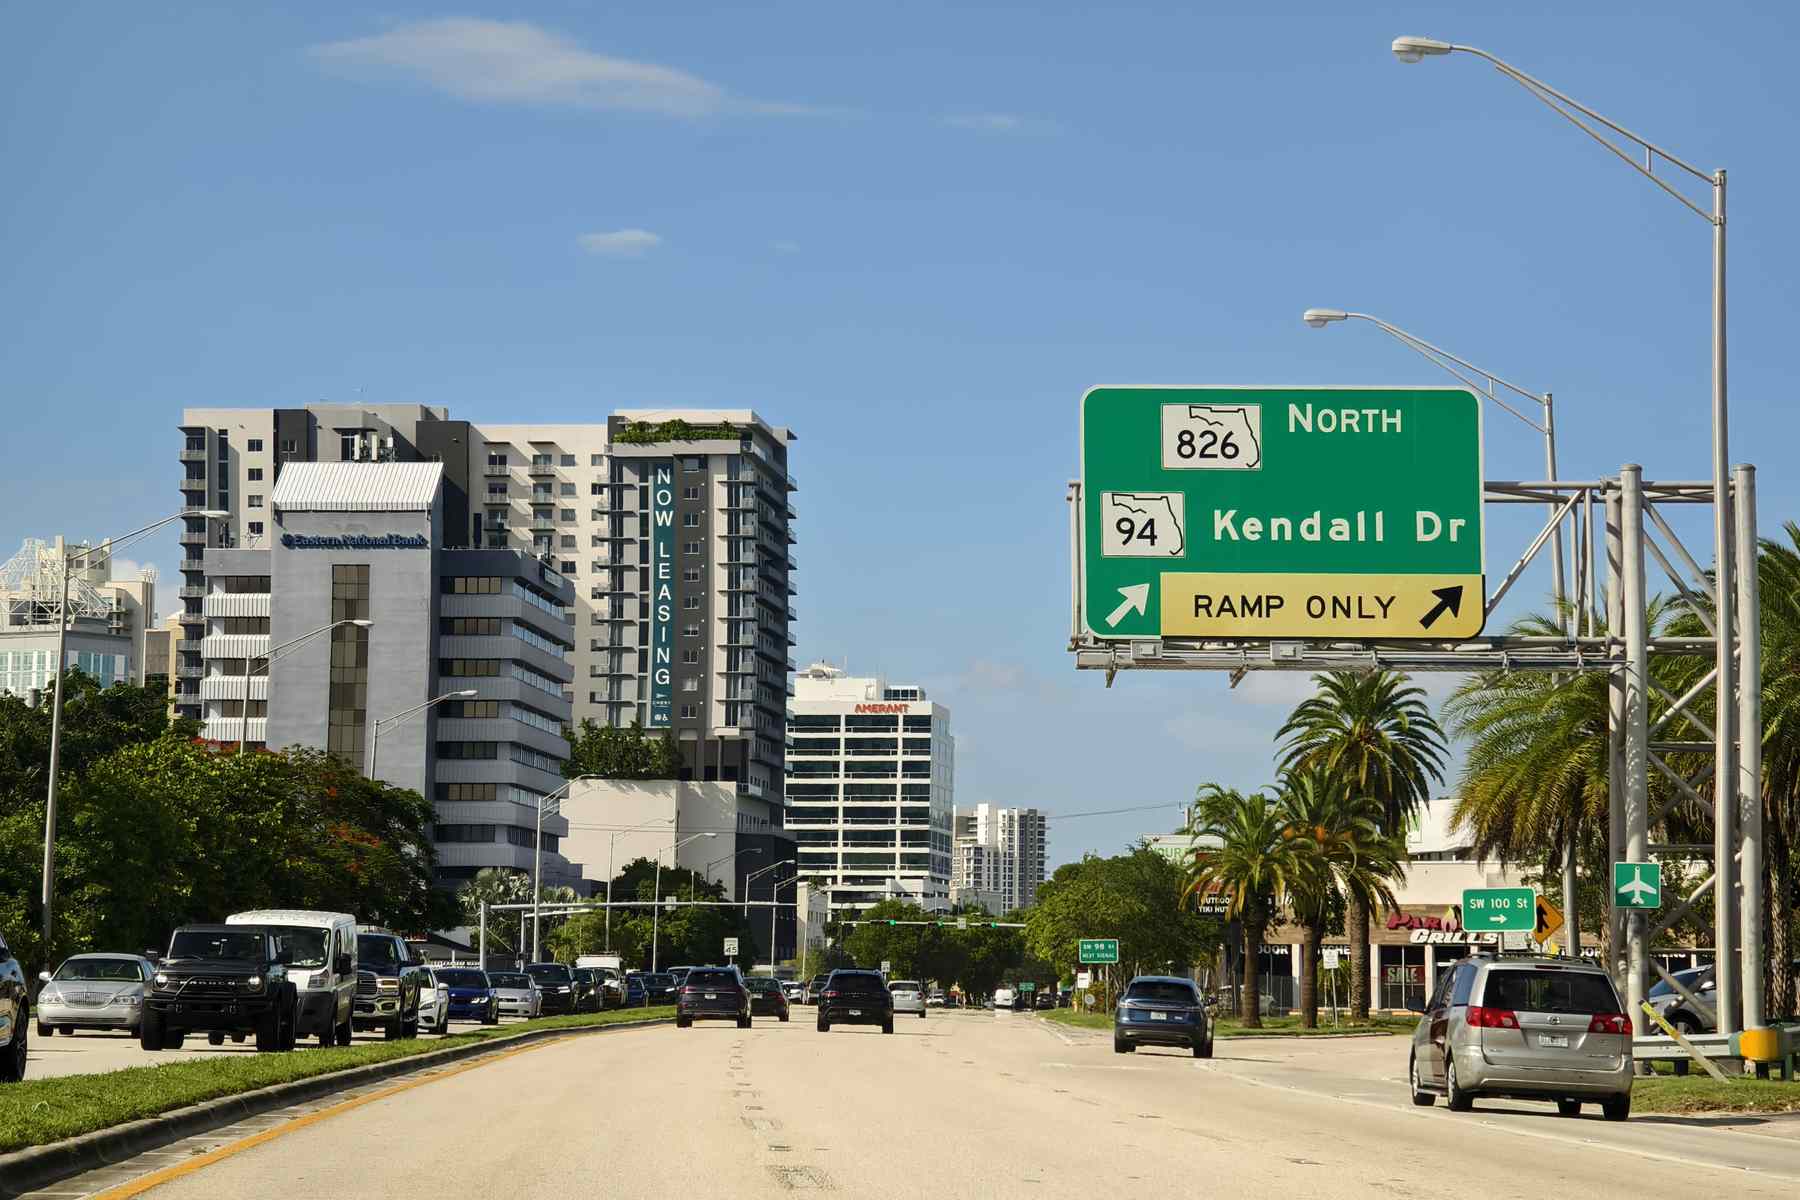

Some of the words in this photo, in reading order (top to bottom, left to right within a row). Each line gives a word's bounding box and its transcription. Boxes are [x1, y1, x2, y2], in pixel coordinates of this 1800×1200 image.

[1288, 403, 1402, 434] NORTH
[1176, 430, 1240, 460] 826
[655, 468, 674, 527] NOW
[1115, 517, 1158, 547] 94
[1213, 508, 1384, 542] Kendall
[1416, 510, 1467, 542] Dr
[294, 534, 339, 547] Eastern
[342, 534, 391, 547] National
[393, 534, 426, 547] Bank
[655, 541, 672, 685] LEASING
[1193, 594, 1285, 618] RAMP
[1306, 595, 1397, 619] ONLY
[855, 703, 910, 714] AMERANT
[1469, 899, 1484, 909] SW
[1491, 898, 1510, 909] 100
[1517, 898, 1528, 909] St
[1410, 929, 1498, 944] GRILLS
[1387, 967, 1418, 984] SALE
